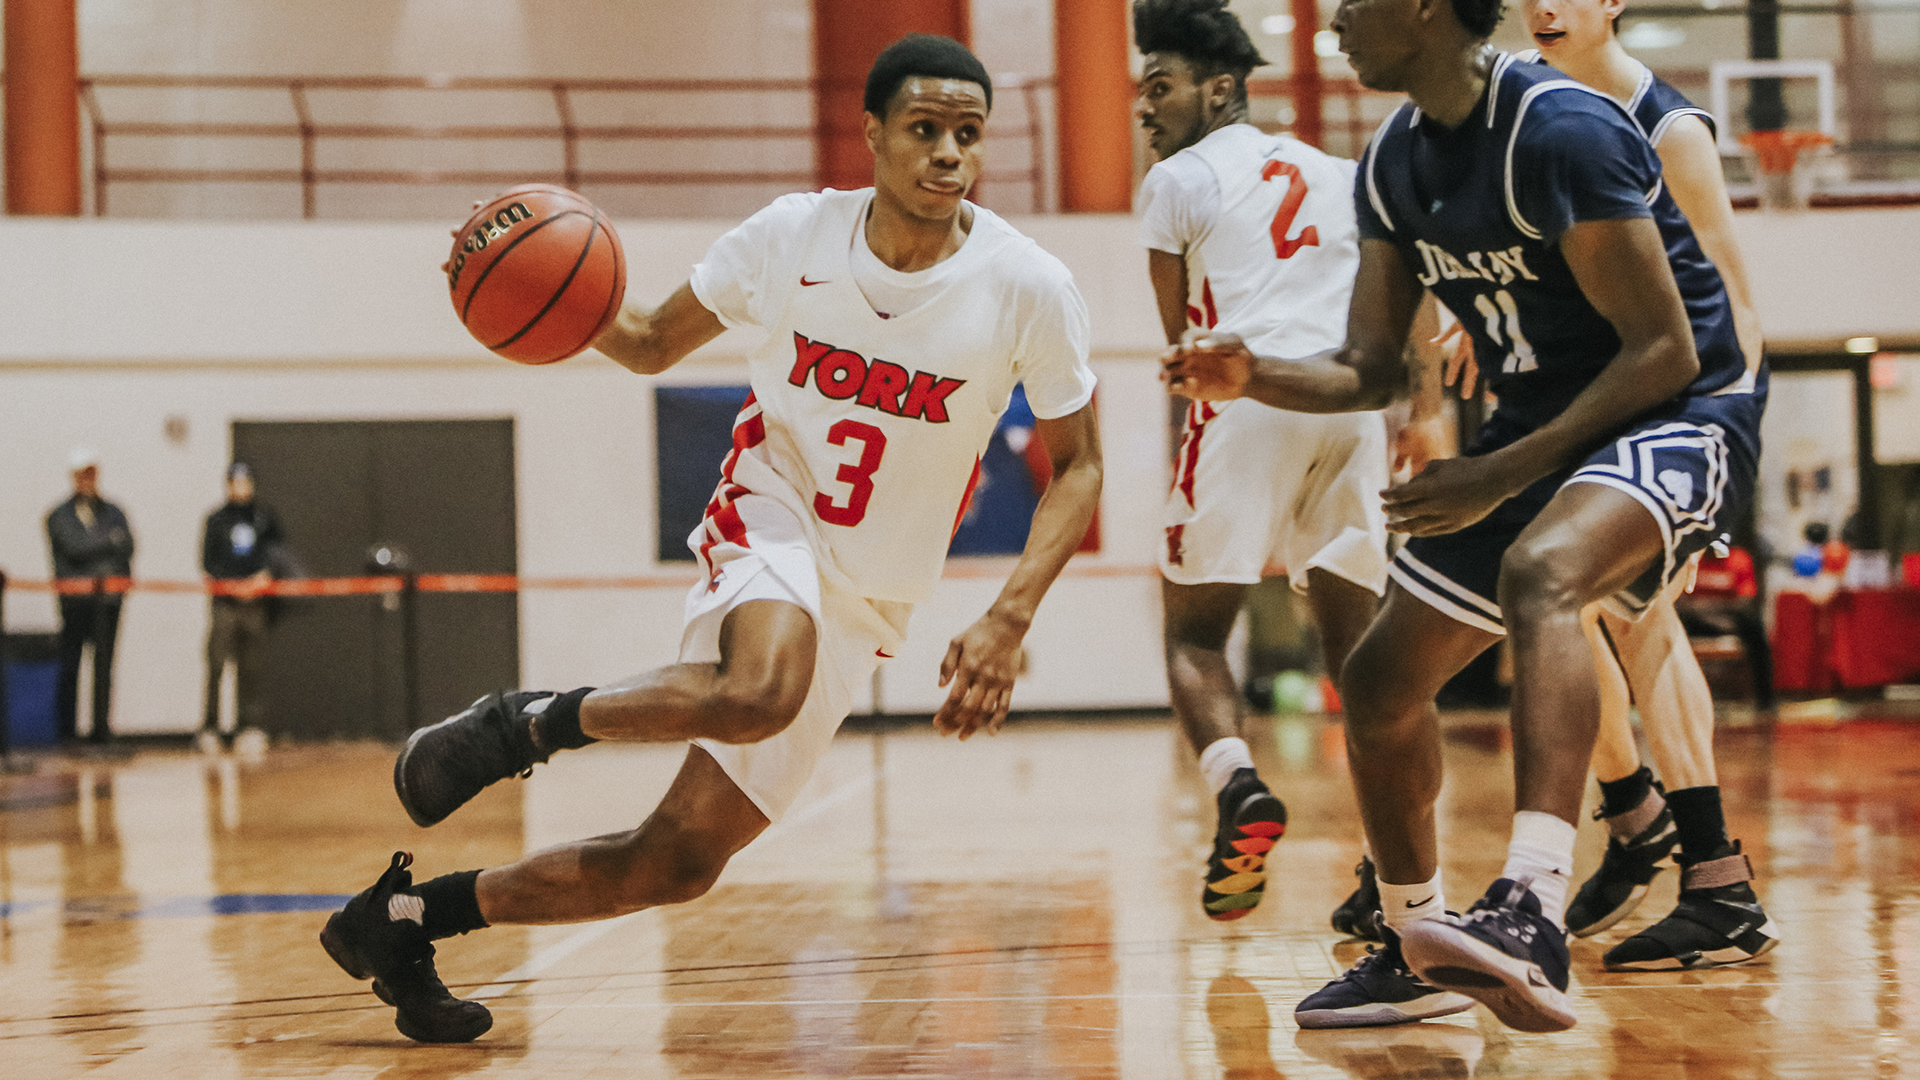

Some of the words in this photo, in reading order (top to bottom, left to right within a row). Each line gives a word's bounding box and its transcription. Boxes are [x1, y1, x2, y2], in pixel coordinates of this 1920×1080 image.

[1260, 158, 1320, 260] 2
[788, 330, 968, 424] YORK
[1474, 289, 1540, 374] 11
[813, 418, 888, 528] 3
